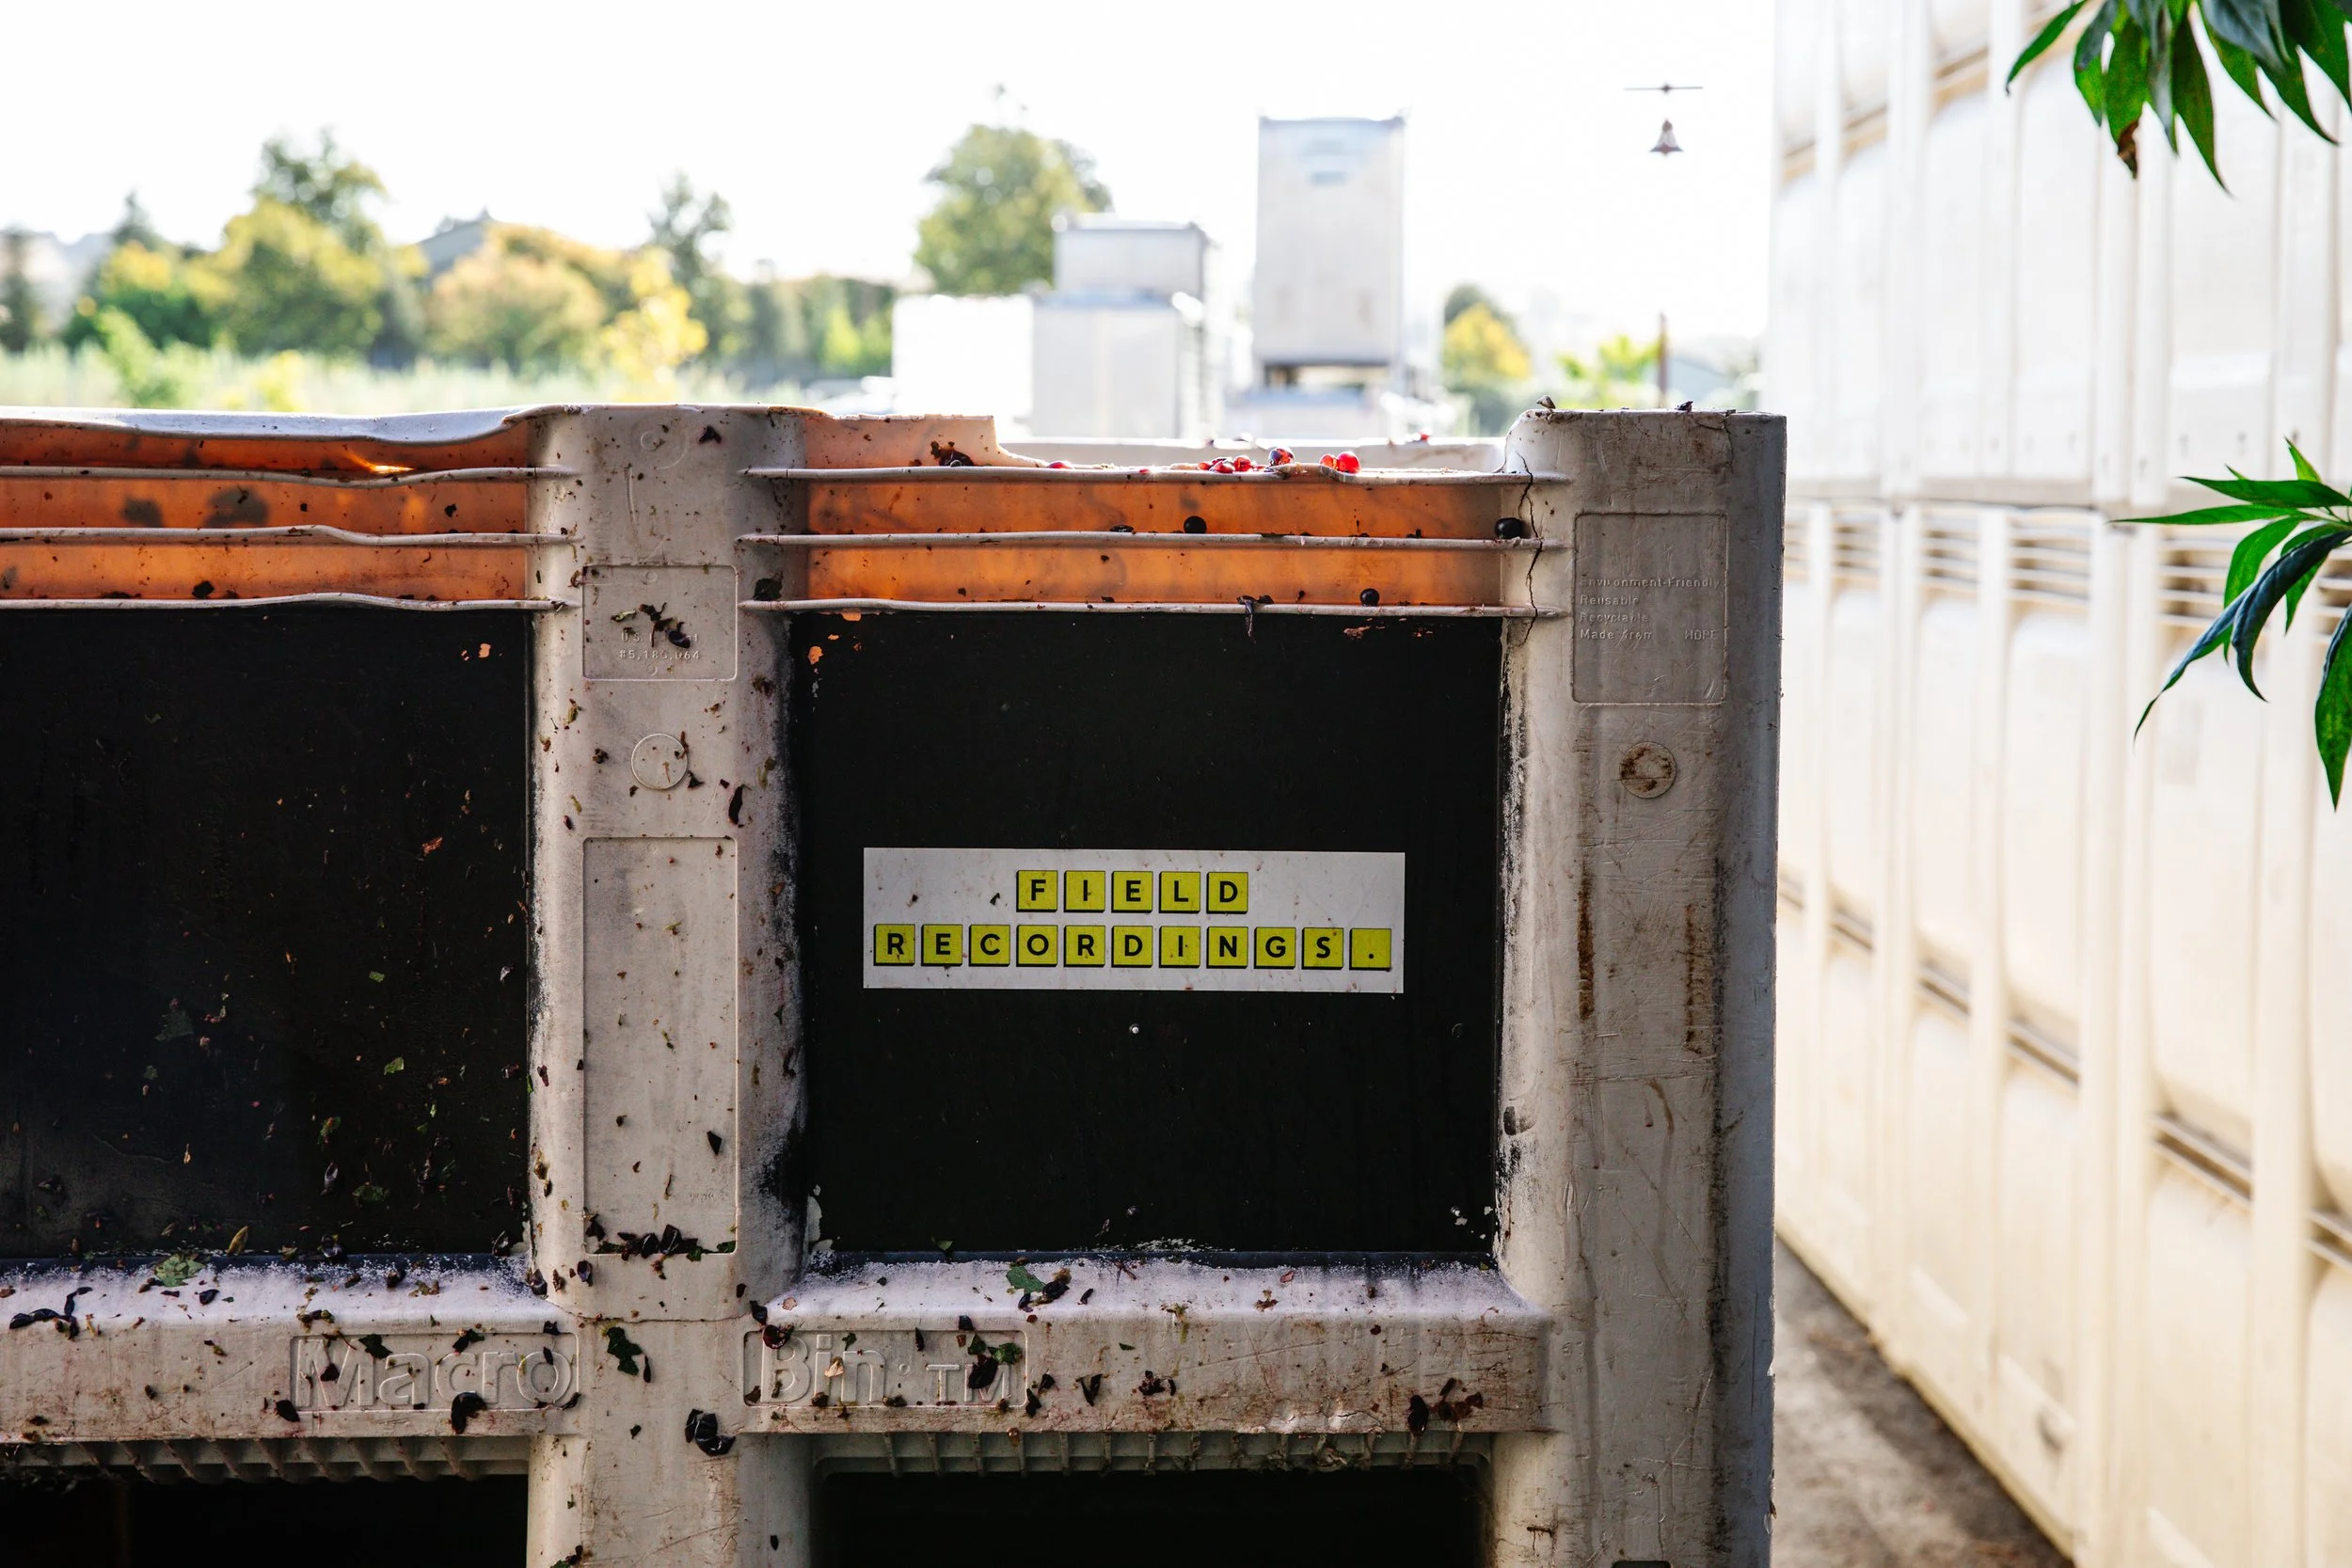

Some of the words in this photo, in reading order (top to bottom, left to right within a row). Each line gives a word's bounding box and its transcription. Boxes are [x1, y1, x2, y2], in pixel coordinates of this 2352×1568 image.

[1580, 594, 1640, 606] Reusable
[1580, 628, 1615, 641] Made
[1030, 879, 1239, 904] FIELD
[887, 932, 1375, 959] RECORDINGS.
[294, 1338, 572, 1407] Macro
[759, 1332, 886, 1403] Bin
